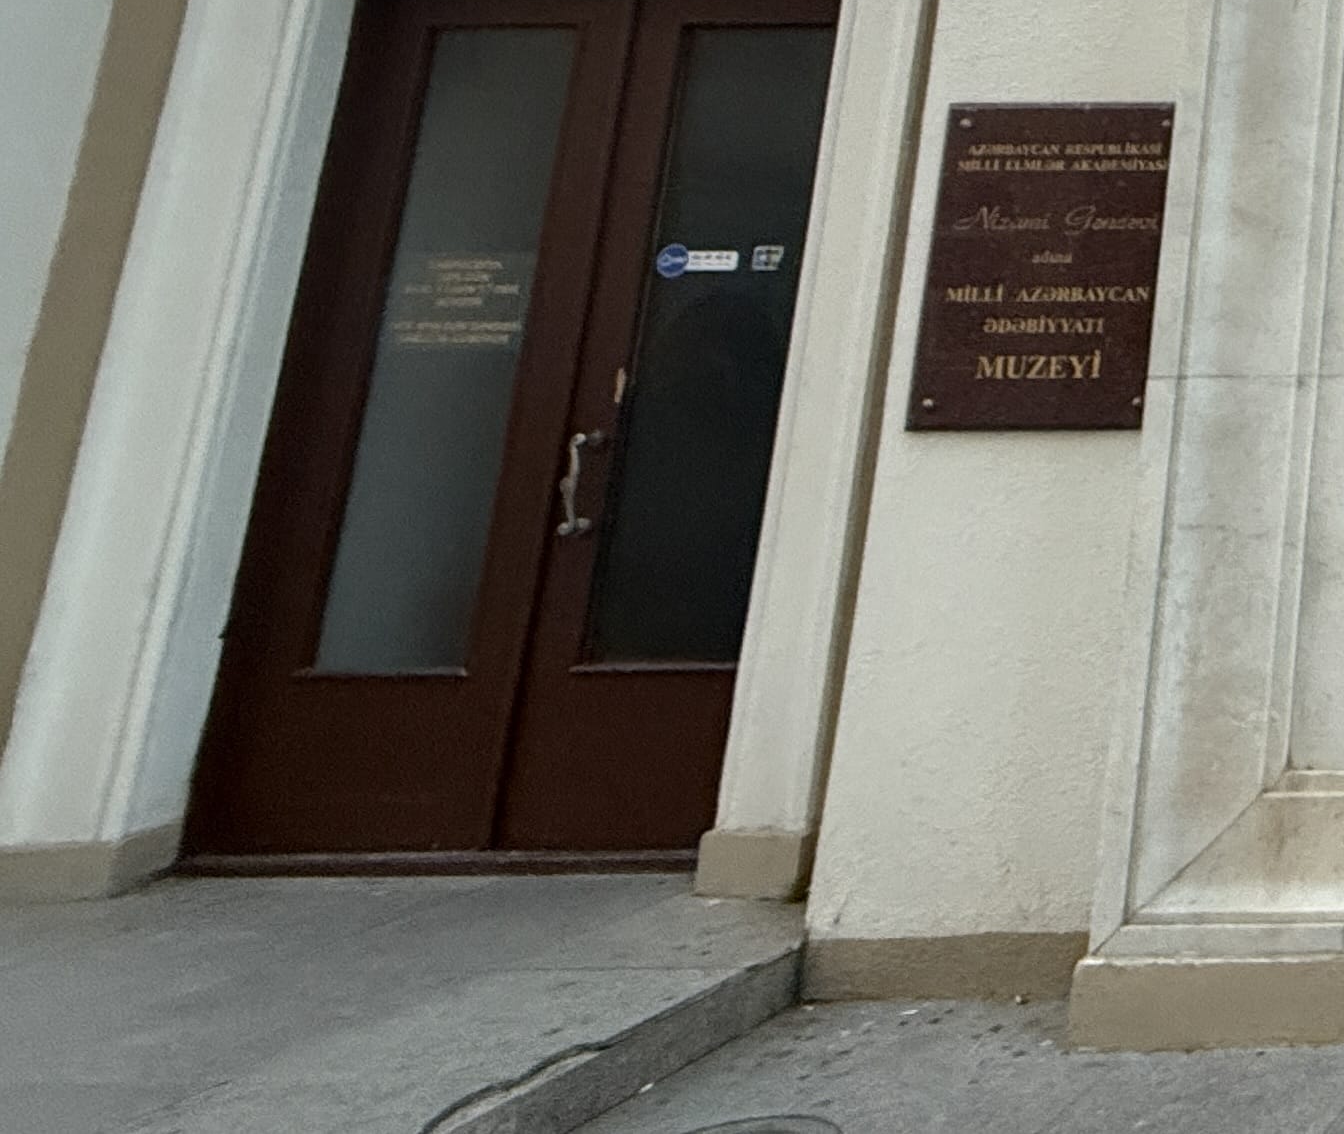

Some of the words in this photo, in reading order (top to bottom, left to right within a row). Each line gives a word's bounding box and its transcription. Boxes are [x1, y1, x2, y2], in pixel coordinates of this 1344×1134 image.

[946, 283, 1004, 303] MİLLİ
[1015, 285, 1150, 303] AZƏRBAYCAN
[982, 314, 1104, 334] ƏDƏBİYYATI
[975, 349, 1102, 380] MUZEYİ
